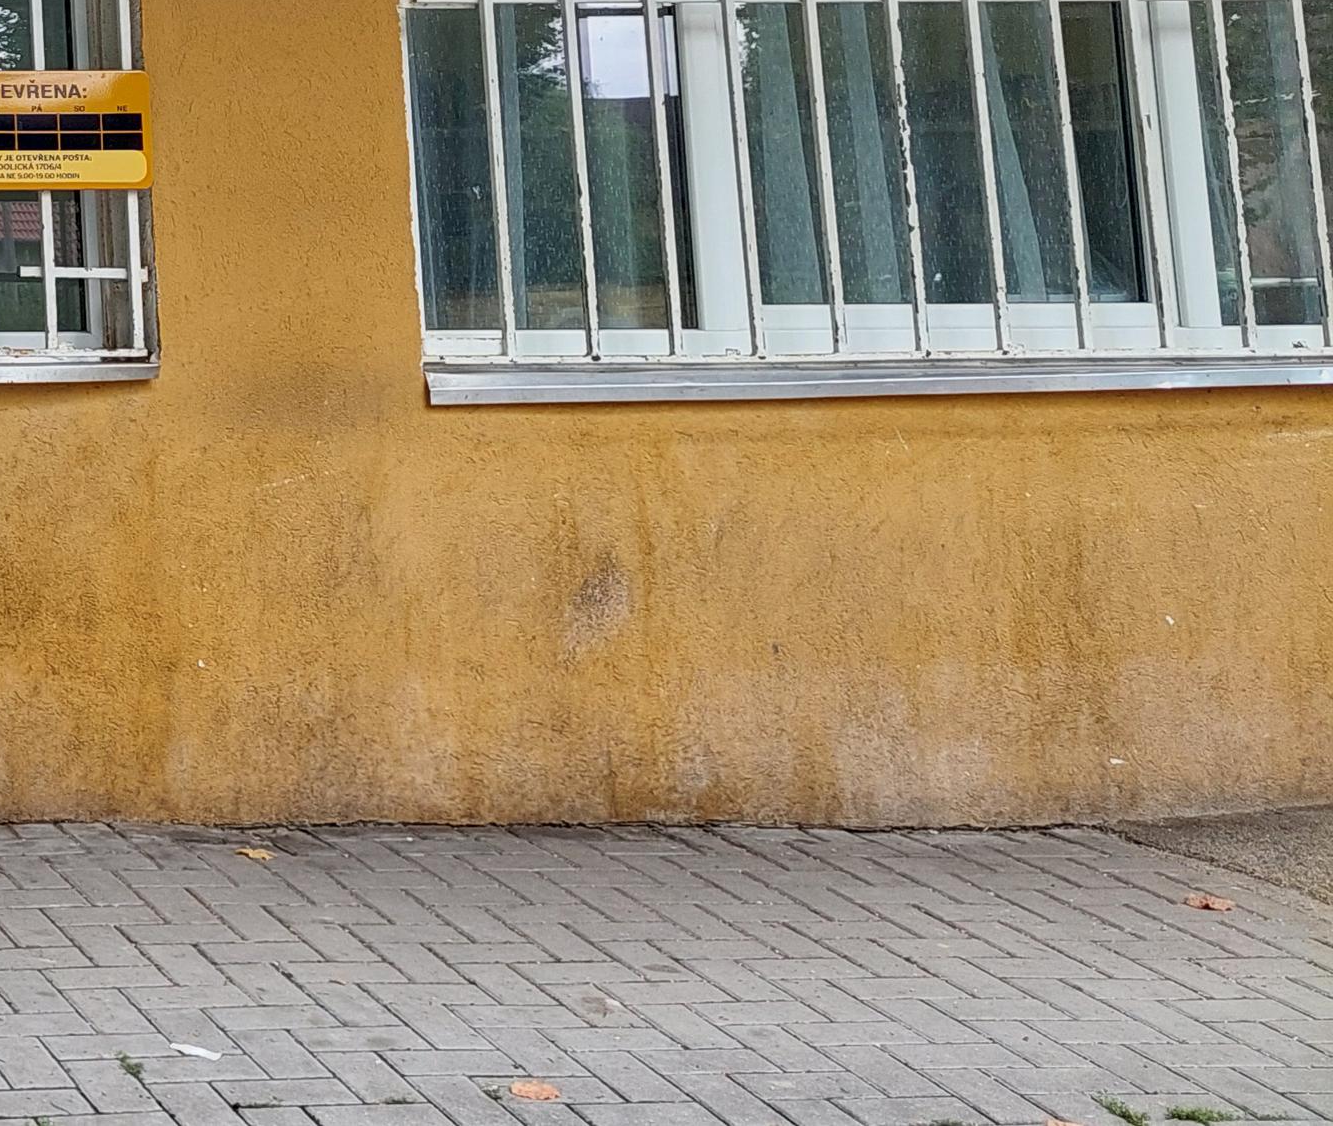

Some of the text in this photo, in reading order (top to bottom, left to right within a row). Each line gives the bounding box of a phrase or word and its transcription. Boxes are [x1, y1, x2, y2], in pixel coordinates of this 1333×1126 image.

[31, 104, 43, 112] PÁ
[4, 154, 14, 162] JE
[15, 153, 61, 162] OTEVŘENA
[62, 153, 93, 162] POŠTA:
[35, 163, 62, 171] 1706/4
